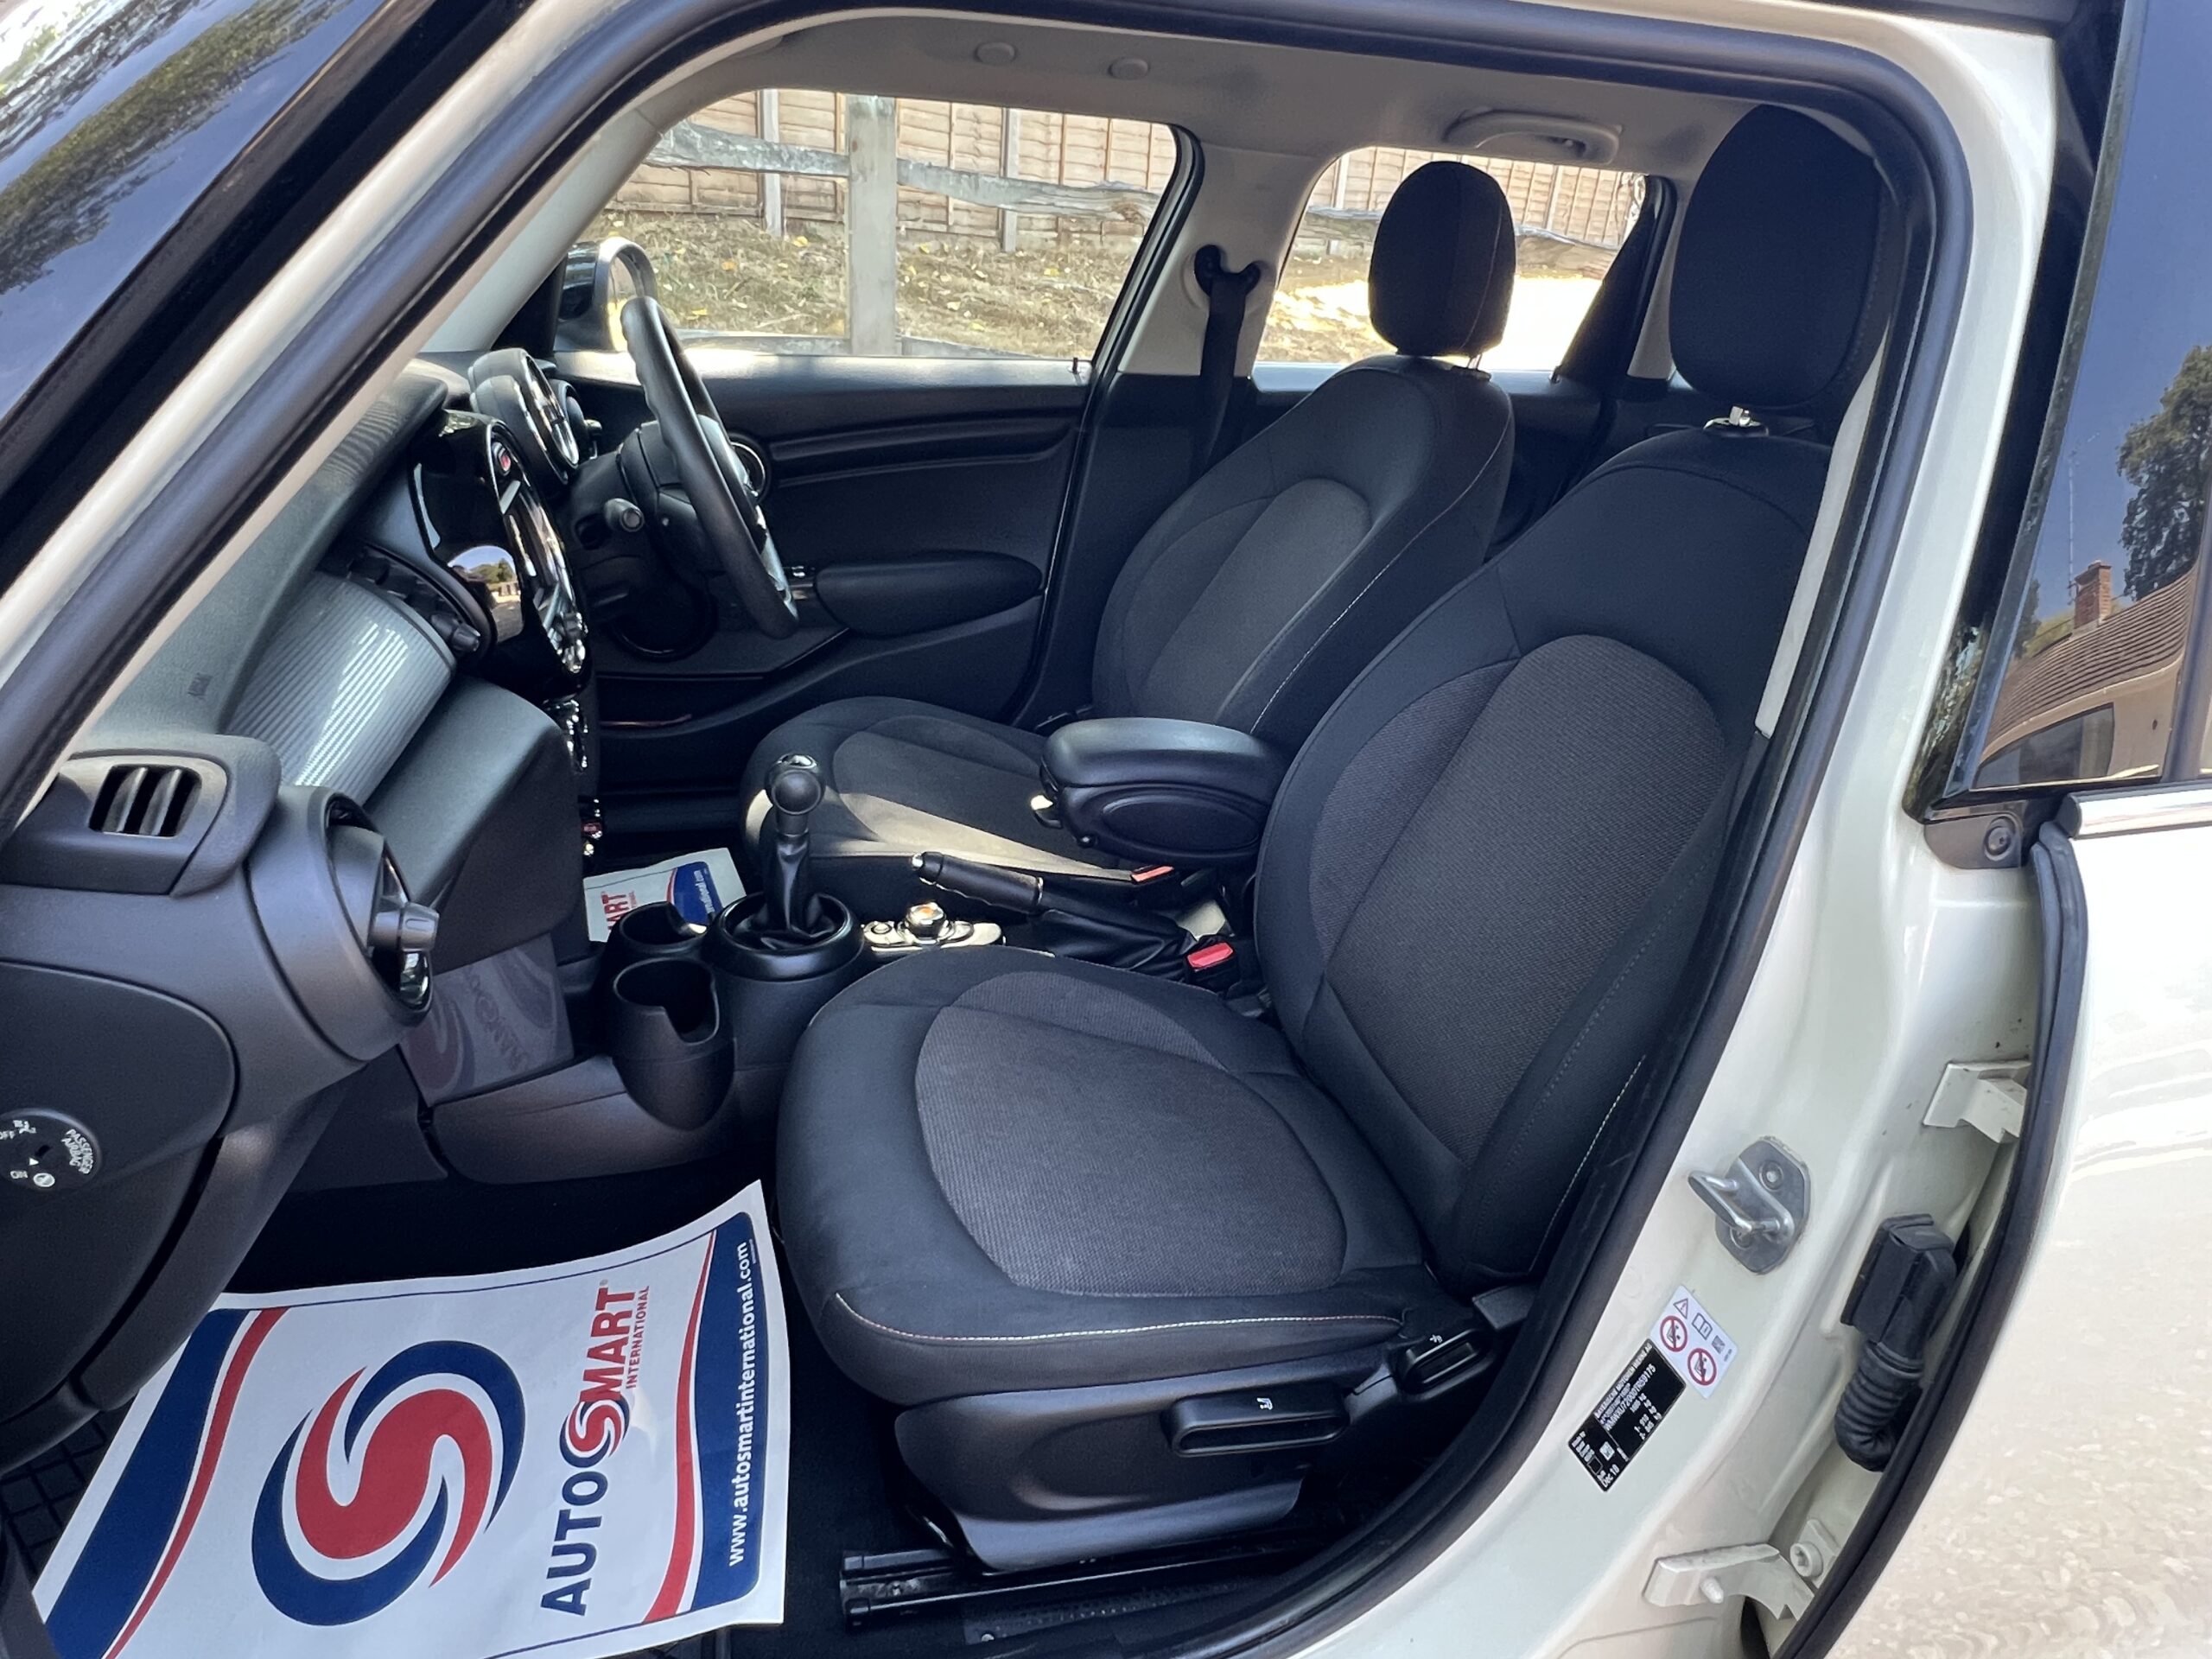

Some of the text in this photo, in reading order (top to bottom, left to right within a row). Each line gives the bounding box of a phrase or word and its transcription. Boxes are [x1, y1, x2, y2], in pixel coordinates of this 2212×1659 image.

[10, 1170, 28, 1179] ON
[66, 1128, 93, 1173] PASSENGER
[626, 1285, 650, 1389] INTERNATIONAL
[729, 1242, 757, 1567] www.autosmartinternational.com
